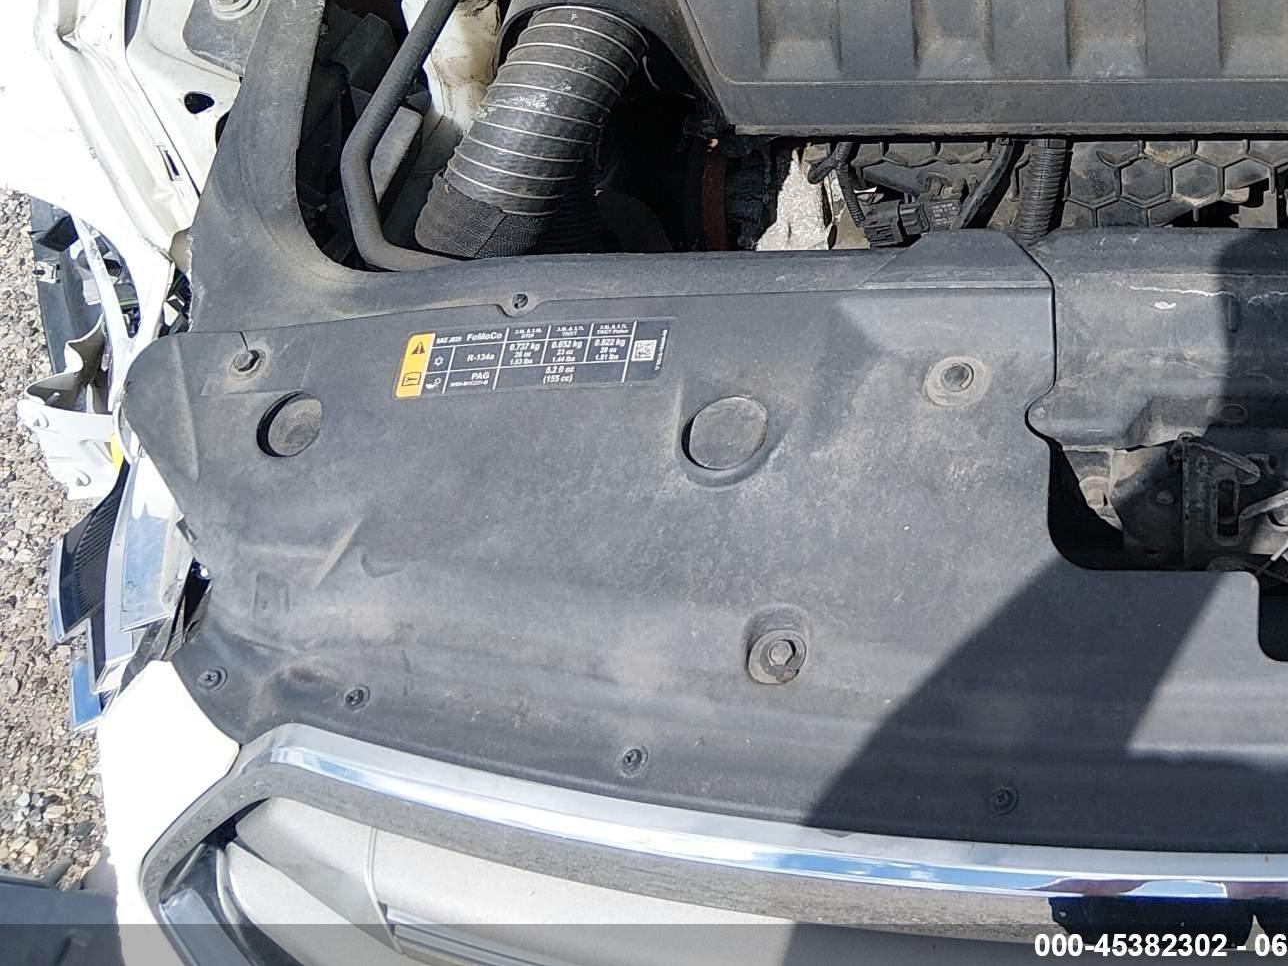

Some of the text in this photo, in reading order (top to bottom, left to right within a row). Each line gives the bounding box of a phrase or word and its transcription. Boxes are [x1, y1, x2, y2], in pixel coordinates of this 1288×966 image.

[466, 332, 503, 341] FoMoCo
[551, 340, 583, 349] 0.652 kg
[615, 337, 626, 347] kg
[510, 342, 541, 352] 0.737 kg
[467, 353, 495, 362] R-134a
[471, 371, 490, 380] PAG
[543, 373, 574, 384] (155 cc)
